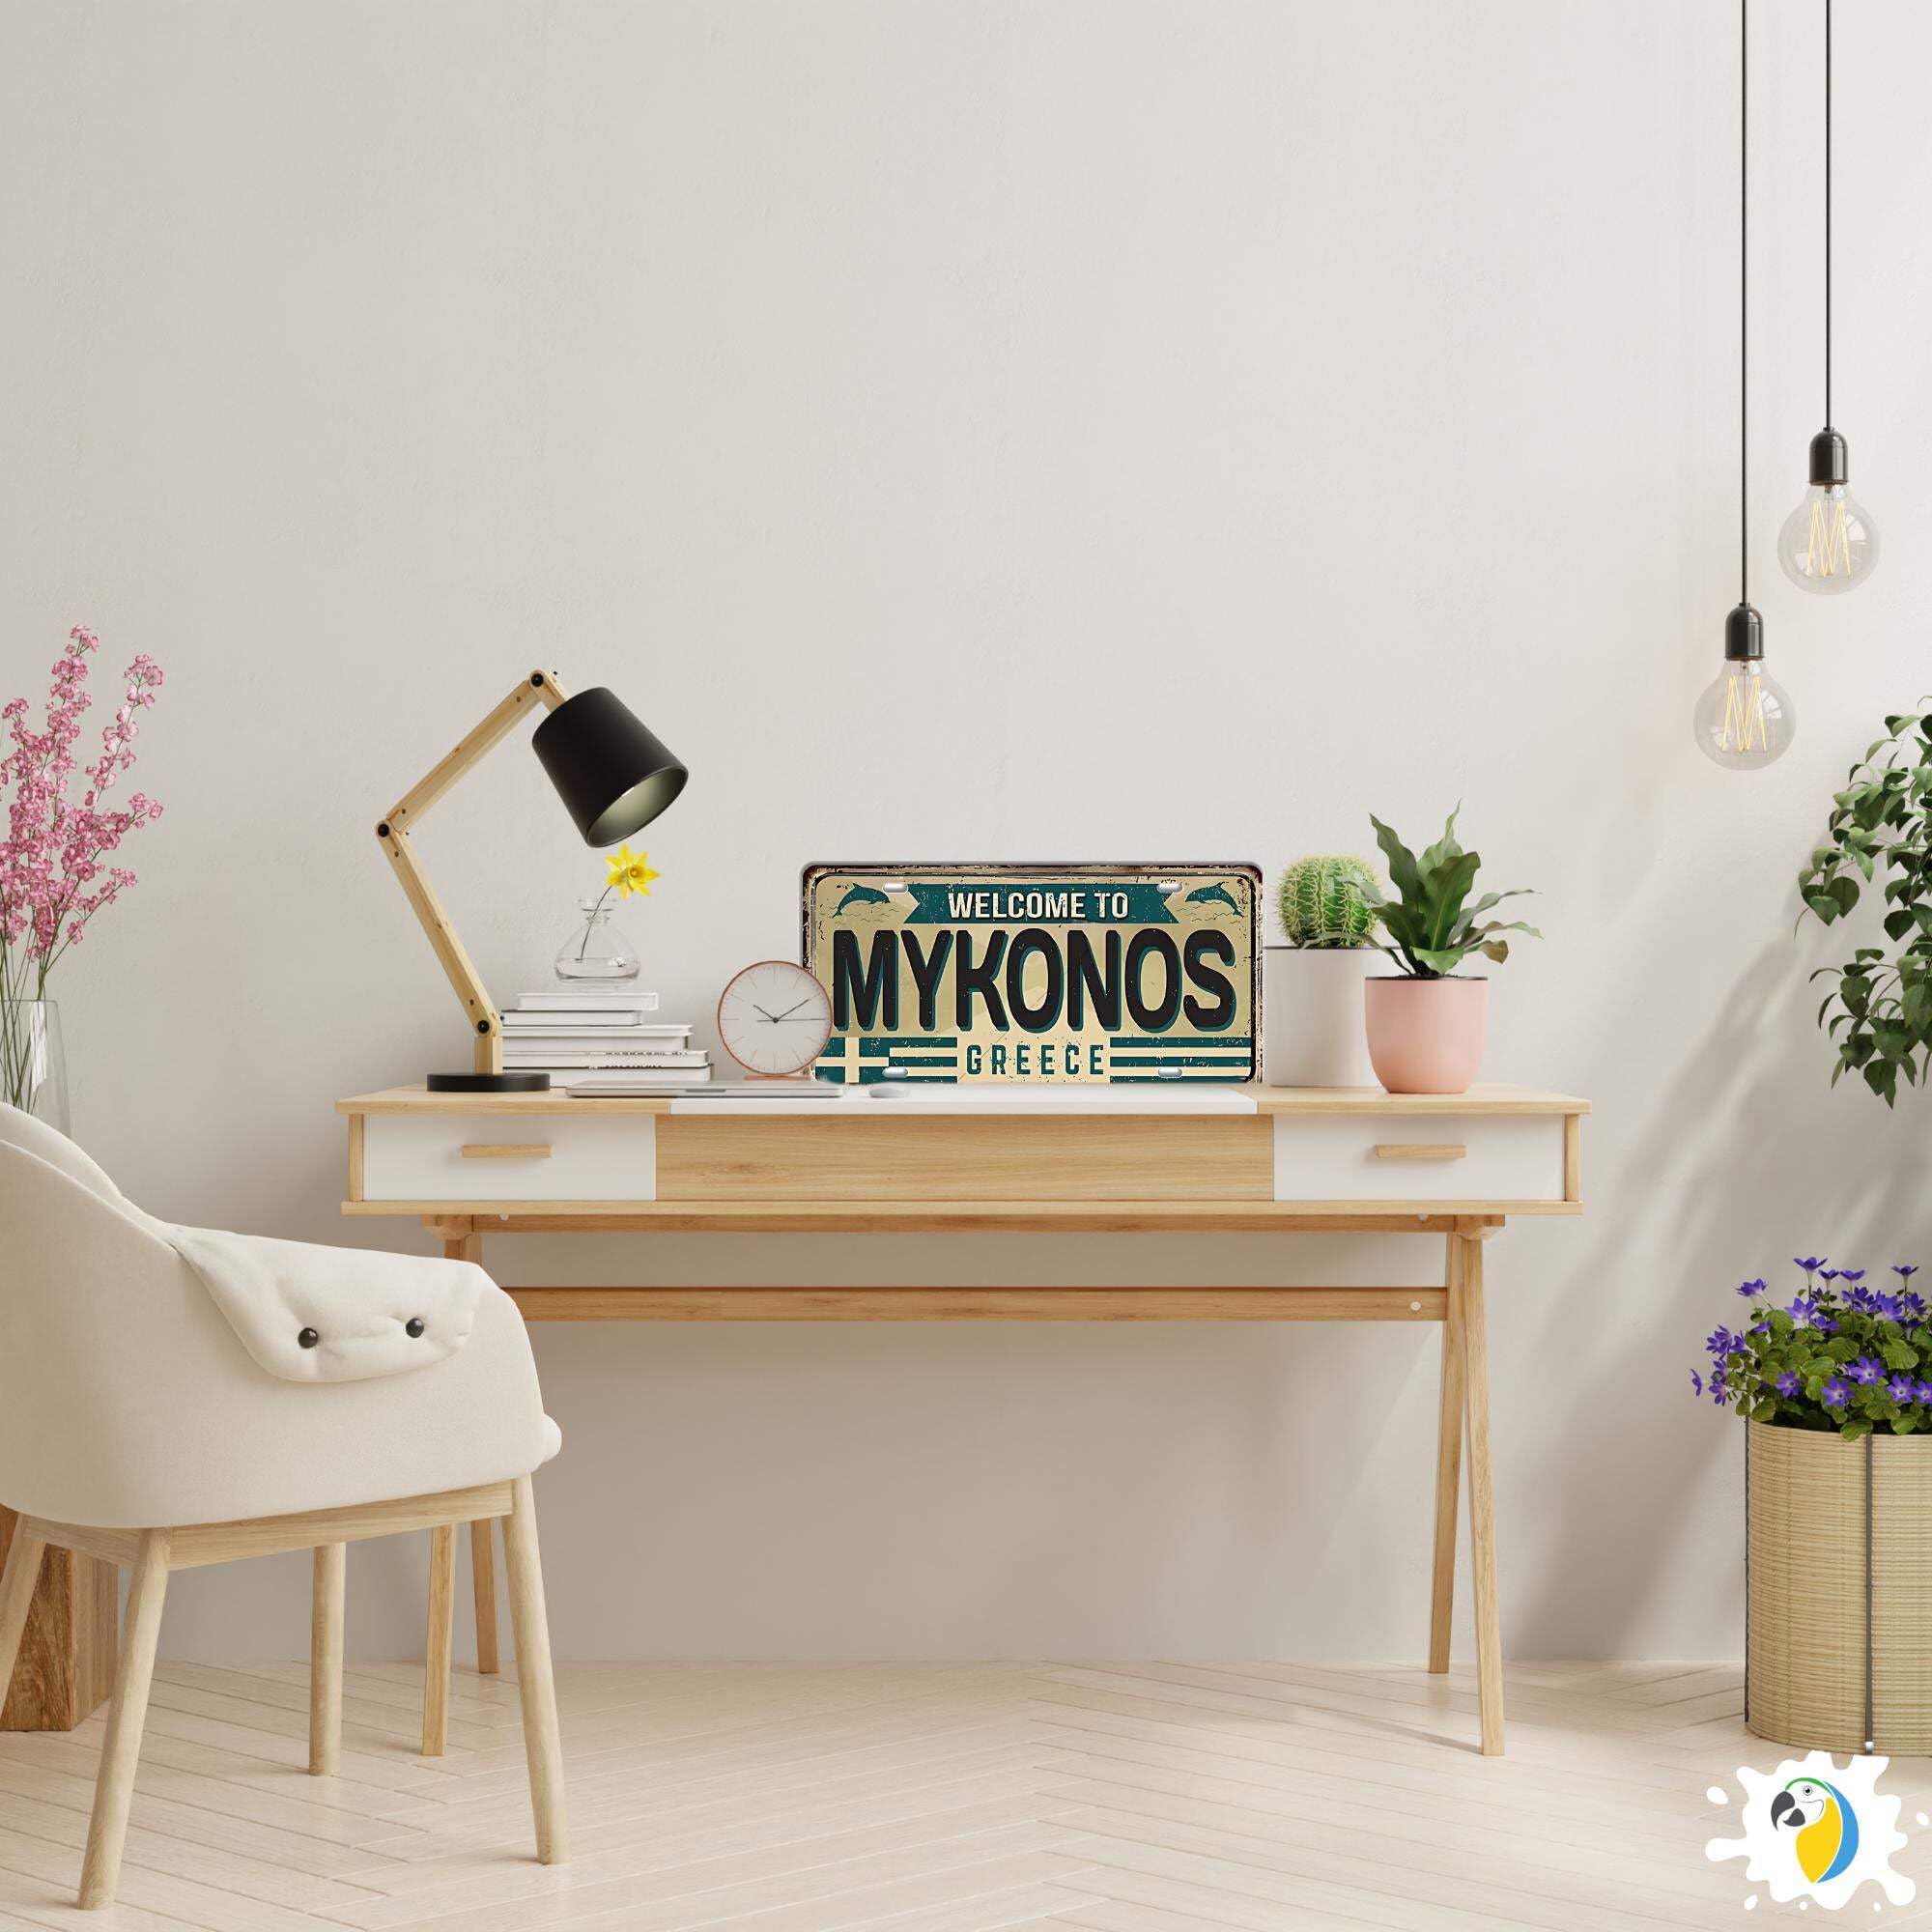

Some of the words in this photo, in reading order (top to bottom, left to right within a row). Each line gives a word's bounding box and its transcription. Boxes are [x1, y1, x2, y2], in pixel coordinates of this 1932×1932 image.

[948, 892, 1084, 920] WELCOME
[1096, 892, 1128, 920] TO
[833, 928, 1237, 1033] MYKONOS
[966, 1044, 1105, 1075] GREECE
